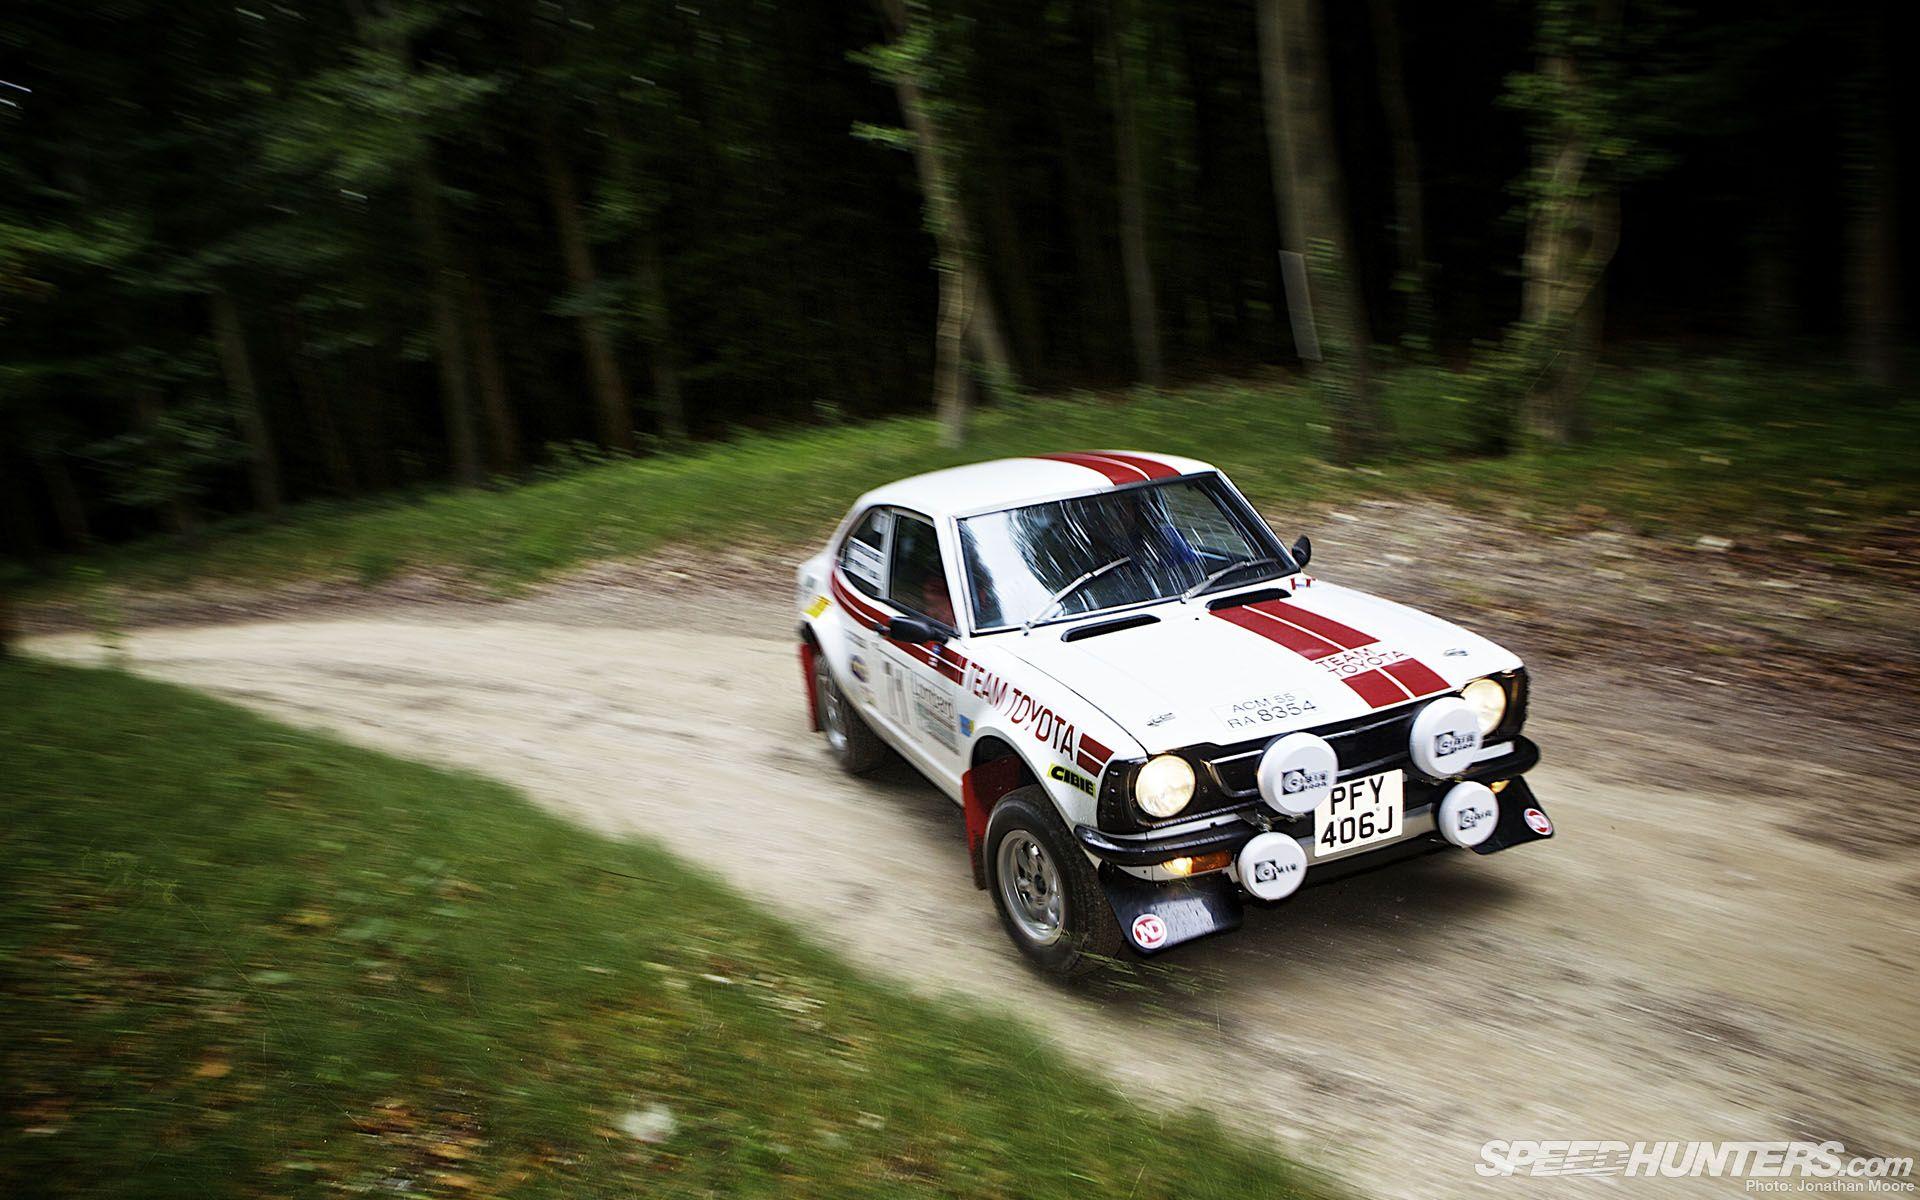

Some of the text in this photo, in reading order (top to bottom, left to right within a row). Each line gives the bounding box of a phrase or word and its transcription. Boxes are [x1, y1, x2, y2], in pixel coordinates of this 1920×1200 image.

[1314, 647, 1377, 670] TEAM
[1327, 651, 1410, 677] TOYOTA
[966, 662, 1009, 711] TEAM
[1003, 687, 1075, 762] TOYOTA
[1227, 700, 1317, 729] RA 8354
[1232, 698, 1273, 714] ACM
[1050, 765, 1095, 797] CIBIE
[1330, 775, 1385, 816] PFY
[1320, 805, 1394, 848] 406J
